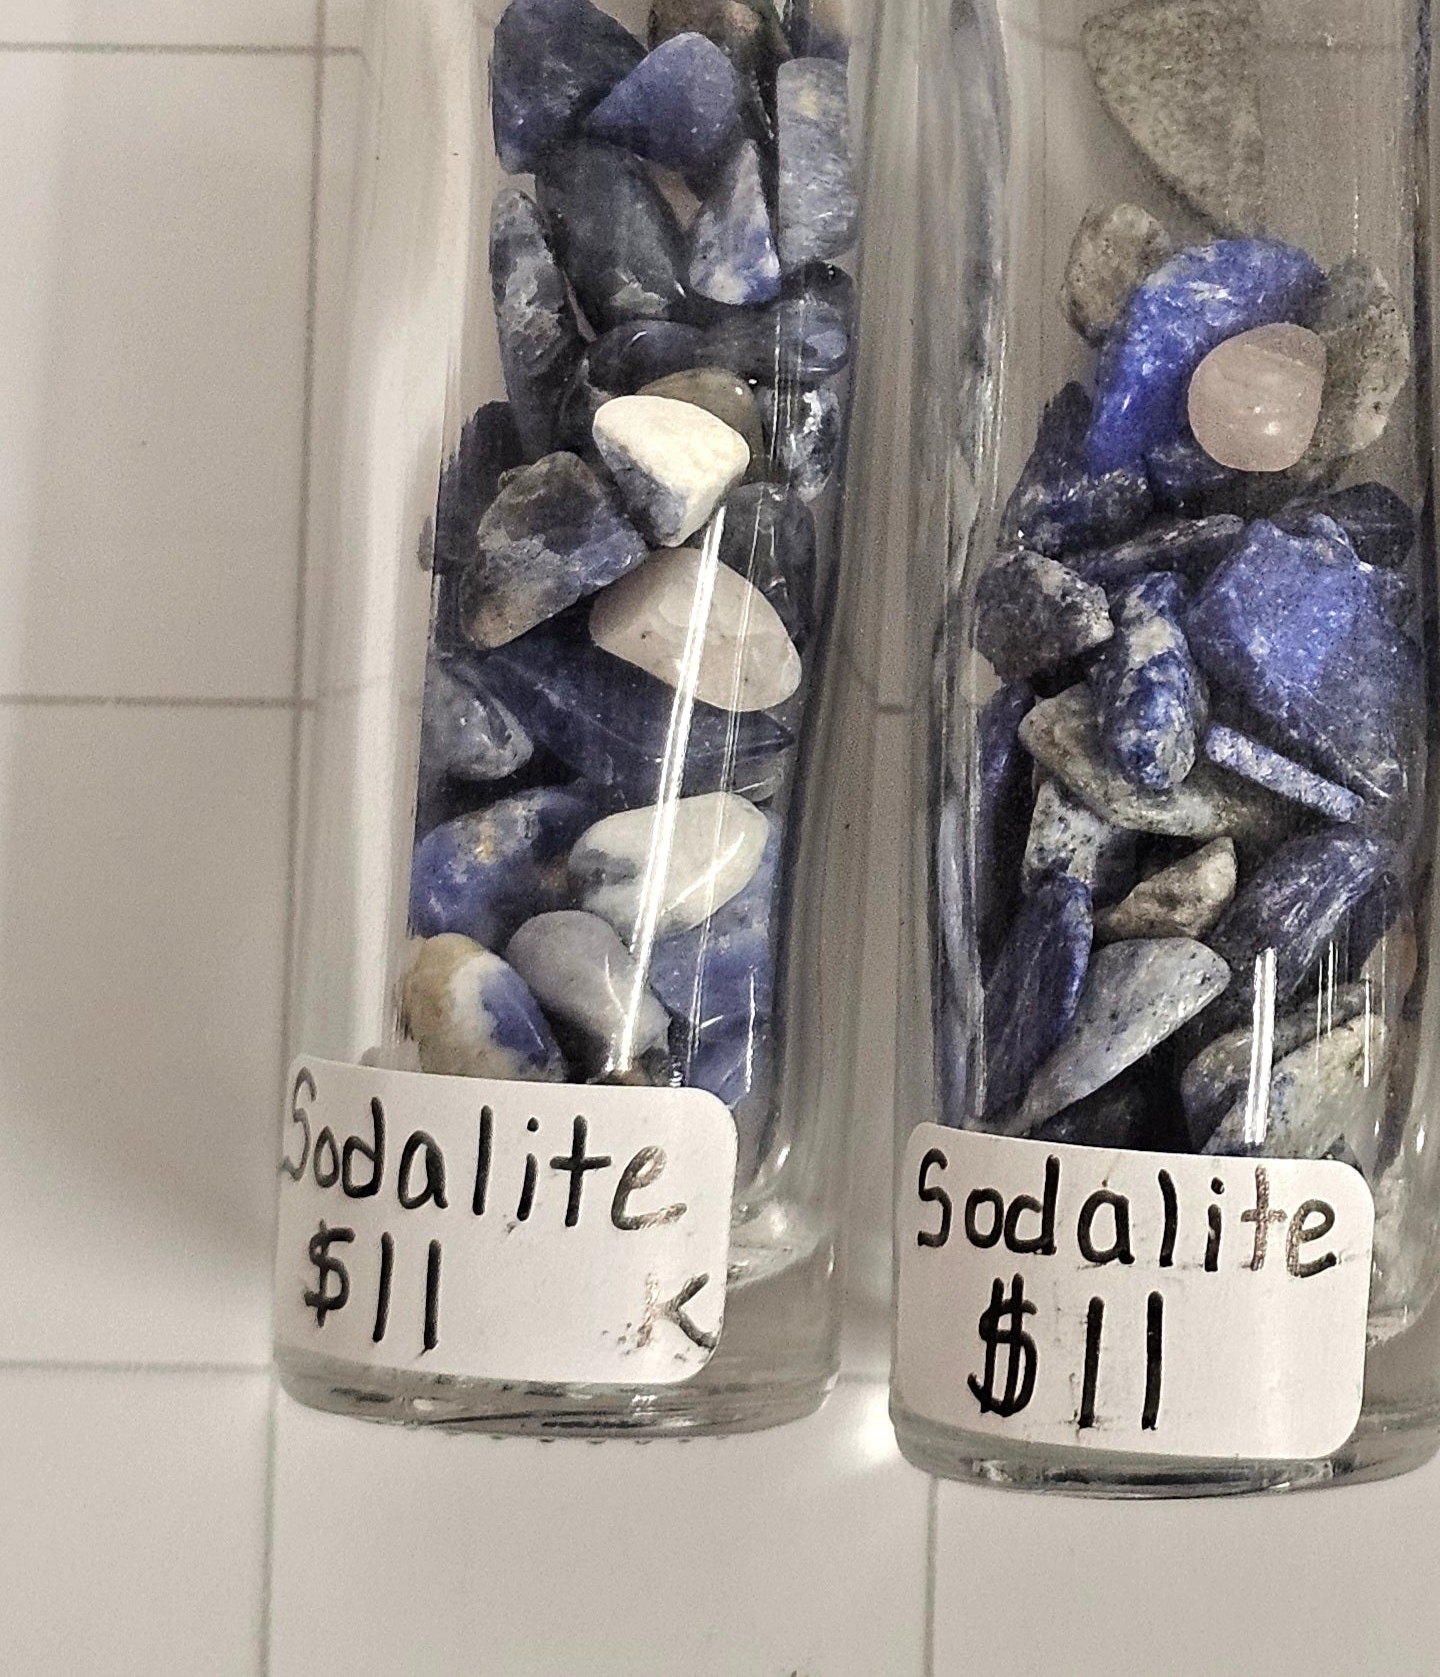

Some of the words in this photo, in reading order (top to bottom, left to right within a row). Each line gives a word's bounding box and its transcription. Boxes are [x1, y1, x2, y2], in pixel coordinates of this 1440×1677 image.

[283, 1067, 687, 1231] Sodalite
[916, 1147, 1338, 1278] Sodalite
[304, 1219, 442, 1353] $11
[966, 1273, 1165, 1431] $11
